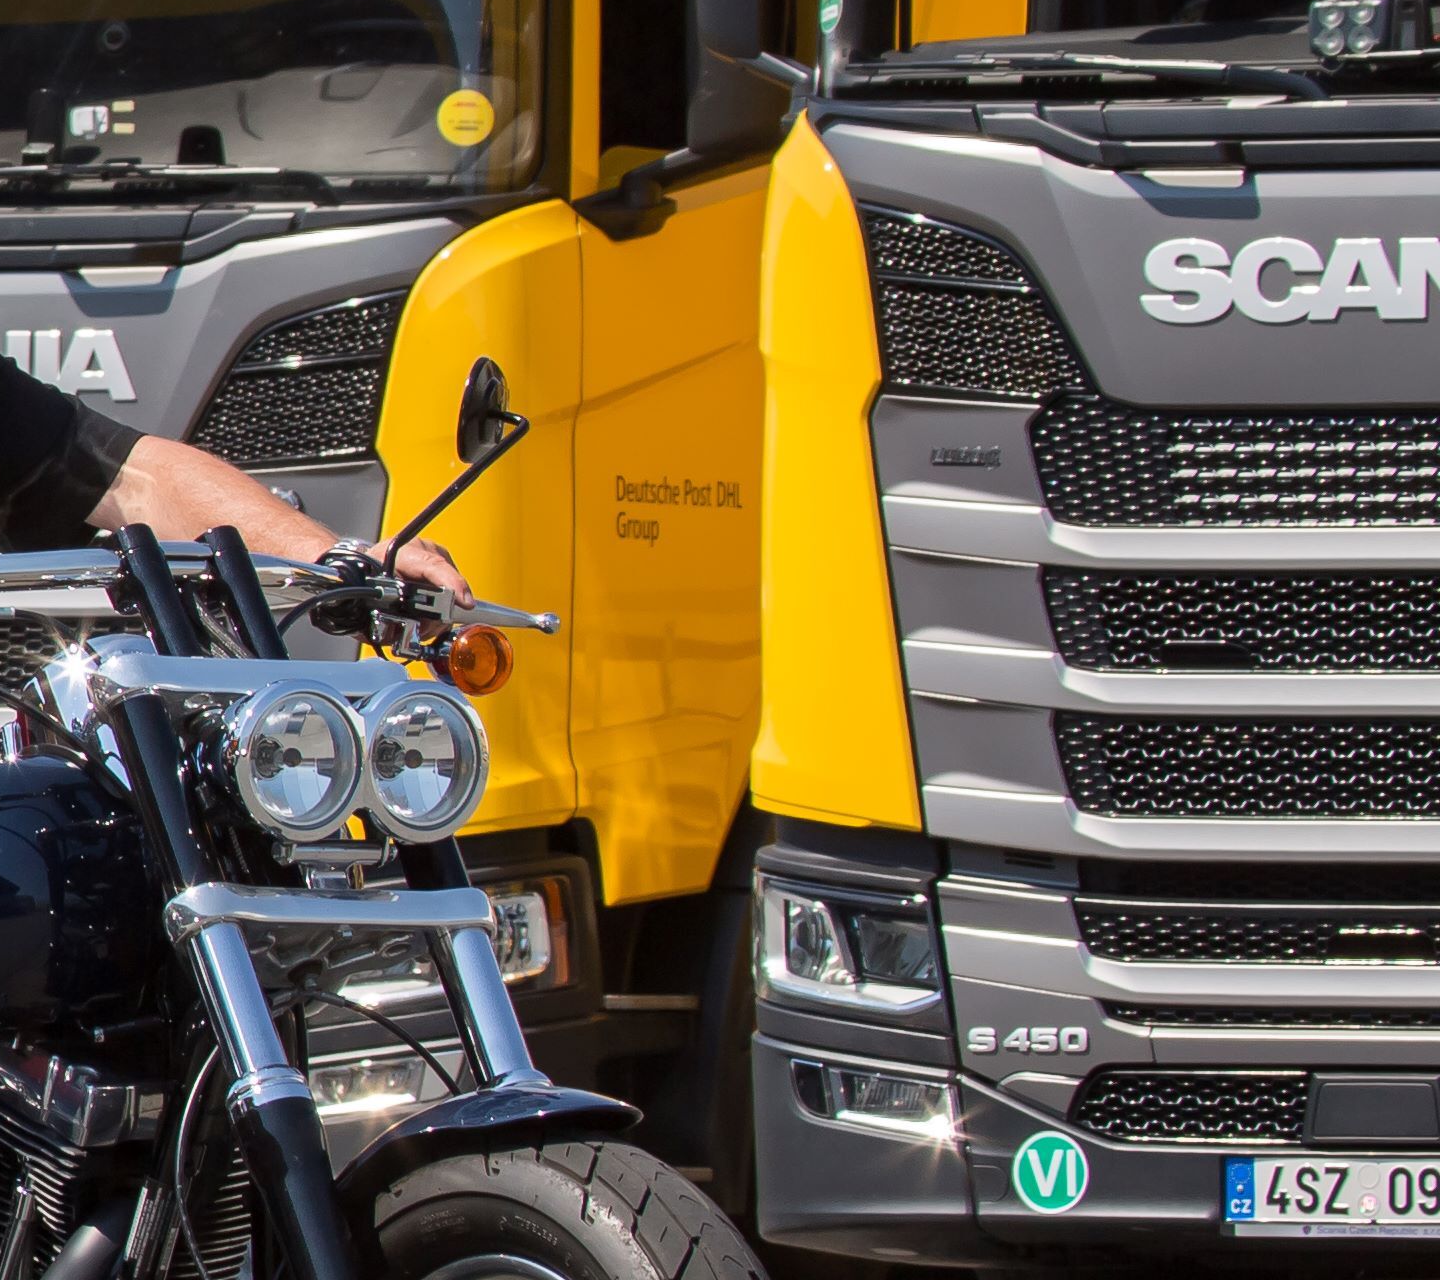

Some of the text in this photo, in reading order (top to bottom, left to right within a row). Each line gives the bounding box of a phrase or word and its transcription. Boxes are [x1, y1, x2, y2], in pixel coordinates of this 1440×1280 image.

[616, 475, 742, 508] Deutsche Post DHL
[616, 511, 659, 548] Group
[967, 1026, 1088, 1053] S 450
[1026, 1148, 1078, 1198] VI
[1266, 1165, 1350, 1215] 4SZ
[1230, 1198, 1252, 1214] CZ
